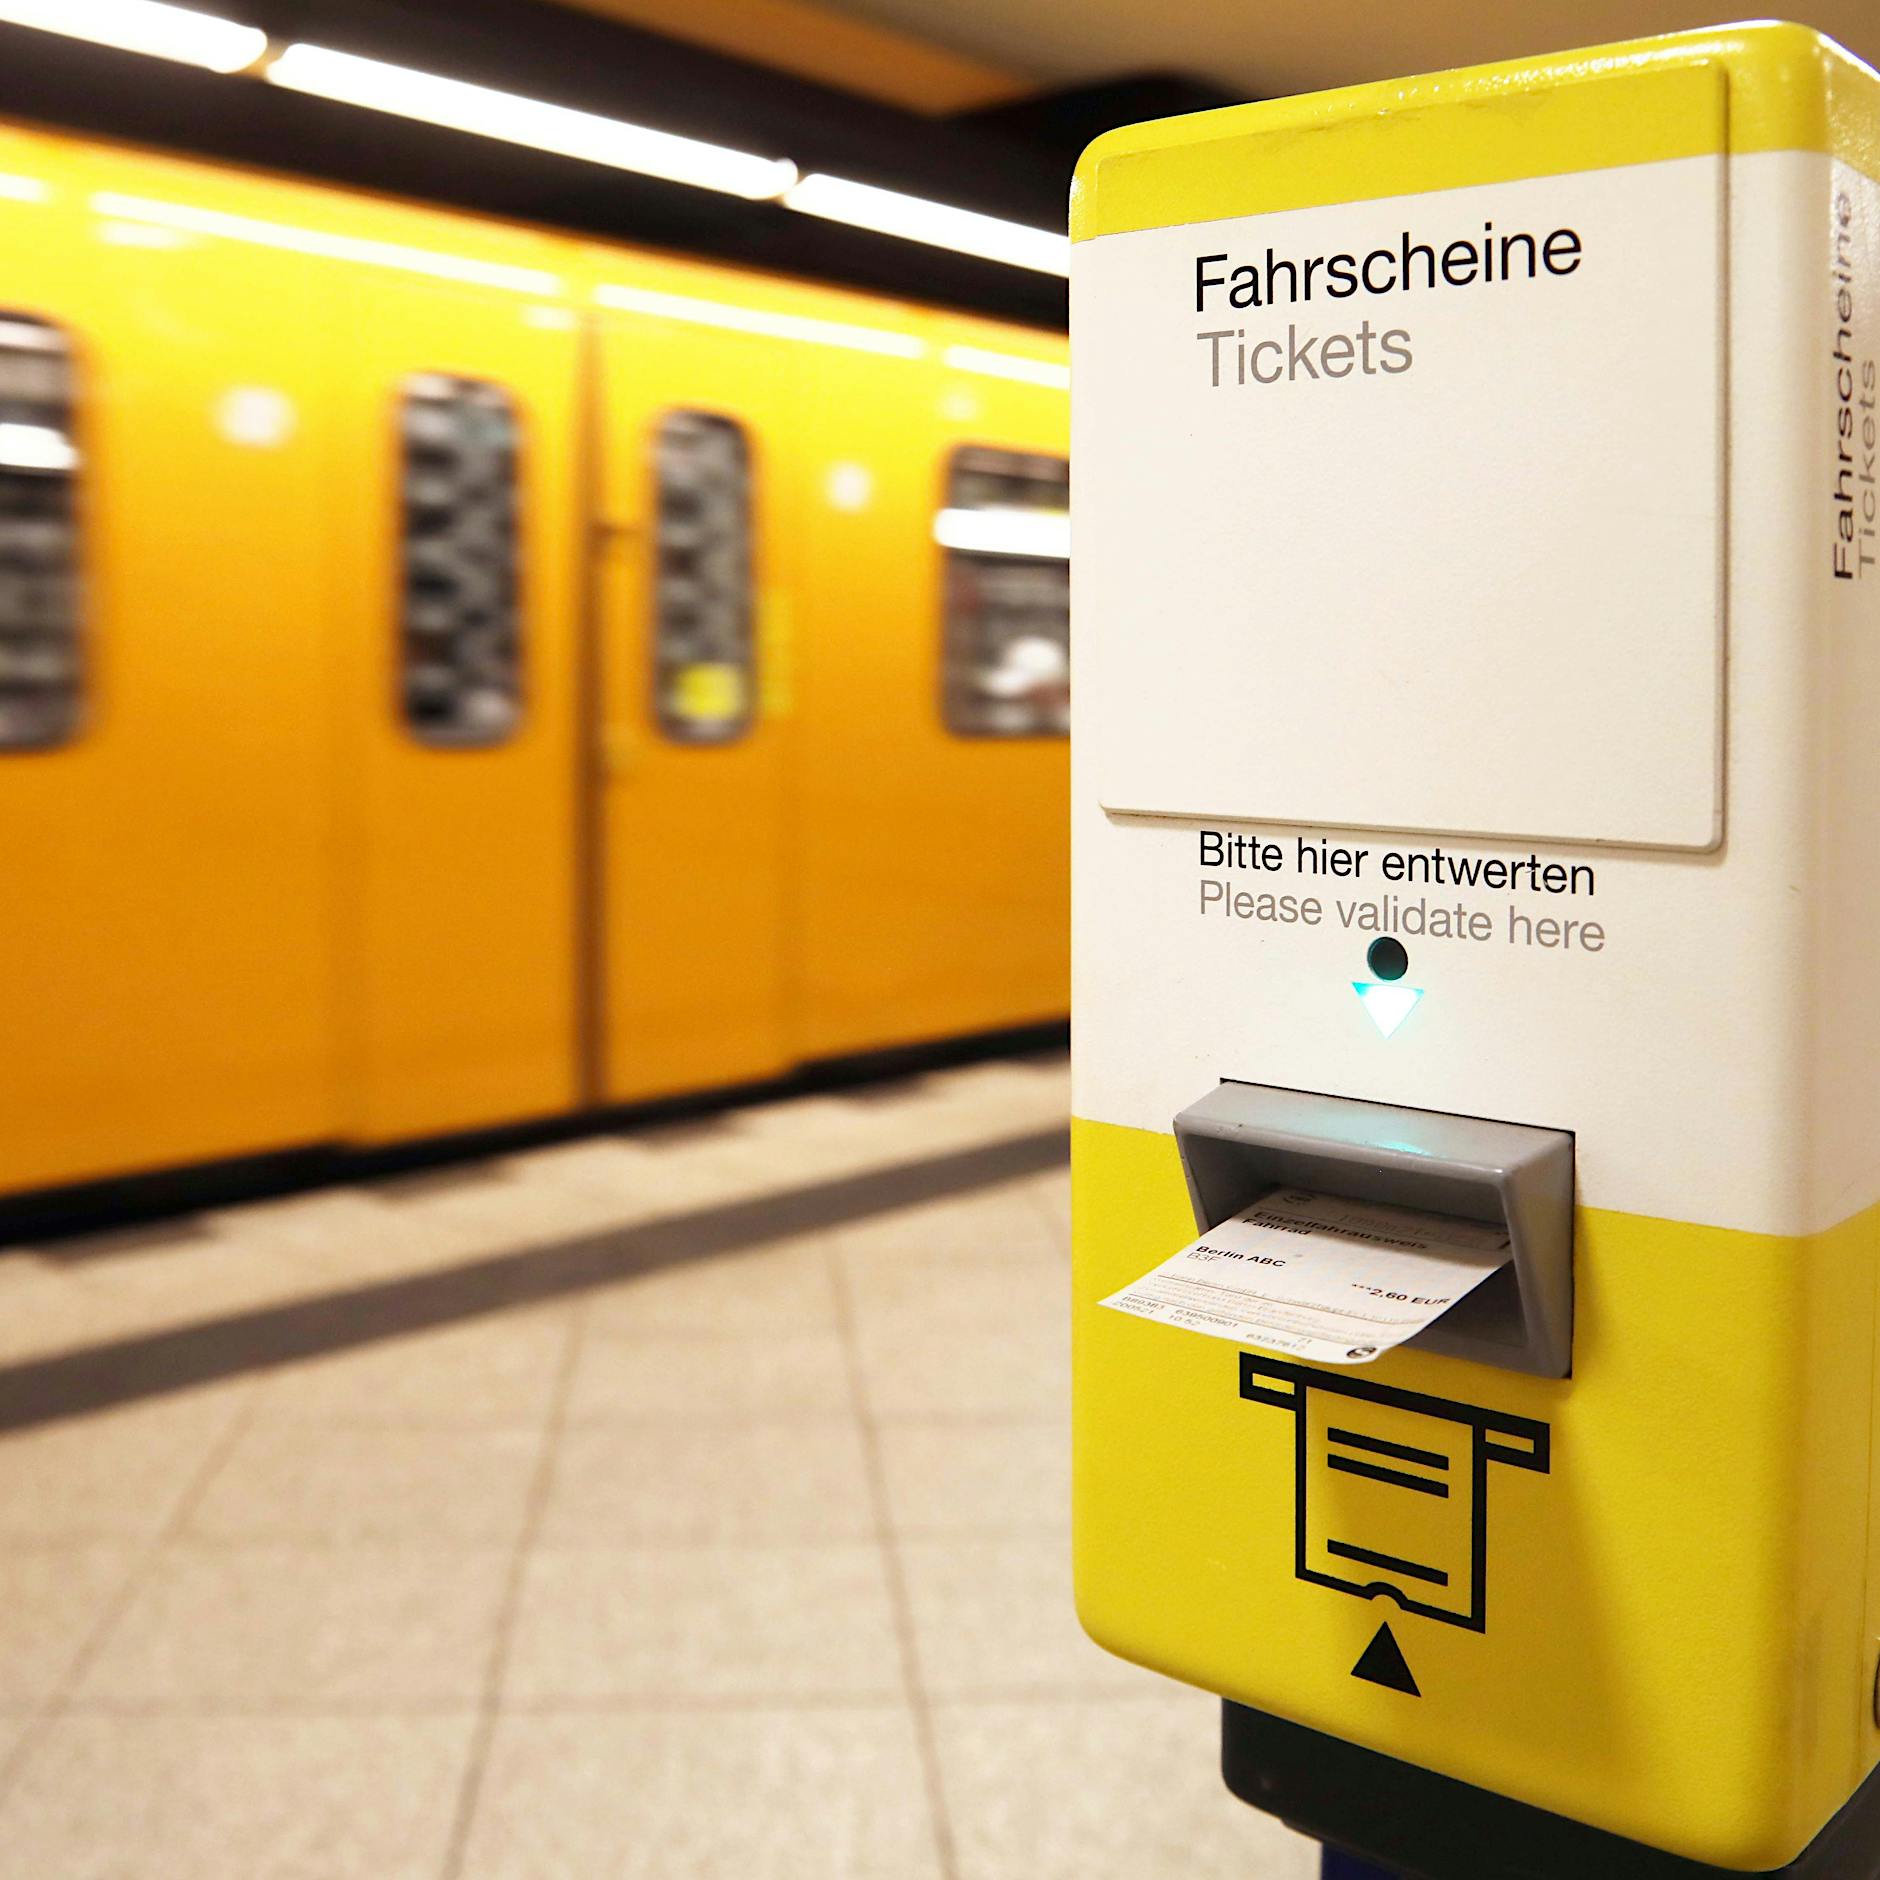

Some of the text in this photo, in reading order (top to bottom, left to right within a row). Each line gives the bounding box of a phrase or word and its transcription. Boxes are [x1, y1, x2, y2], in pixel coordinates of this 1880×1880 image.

[1196, 222, 1582, 313] Fahrscheine
[1197, 320, 1414, 388] Tickets
[1832, 191, 1855, 581] Fahrscheine
[1857, 360, 1877, 579] Tickets
[1199, 831, 1595, 896] Bitte hier entwerten
[1200, 879, 1606, 952] Please validate here
[1186, 1251, 1219, 1264] B3F
[1195, 1245, 1287, 1268] Berlin ABC
[1242, 1217, 1311, 1237] Fahrrad
[1253, 1210, 1429, 1250] Einzelfahrausweis
[1410, 1297, 1451, 1305] EUR
